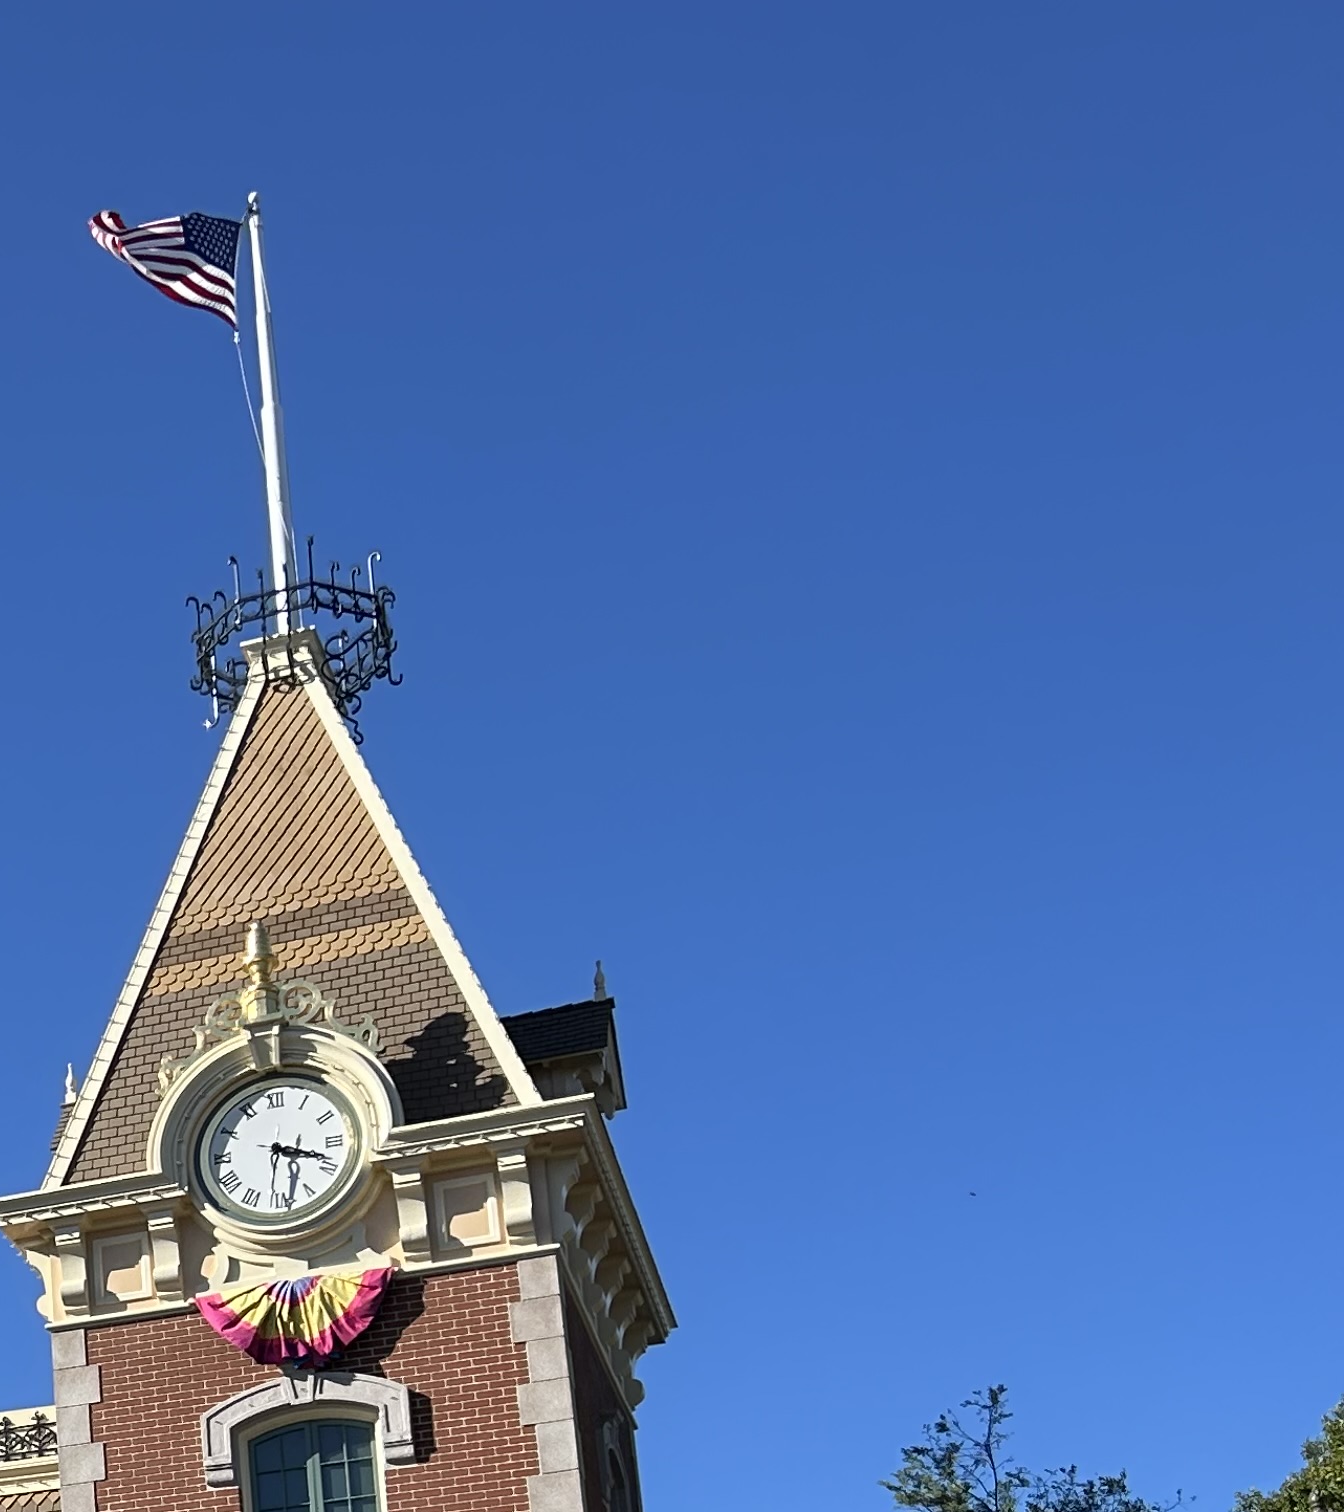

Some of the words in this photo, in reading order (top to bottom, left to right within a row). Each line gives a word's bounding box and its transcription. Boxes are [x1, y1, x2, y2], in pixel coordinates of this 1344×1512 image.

[267, 1092, 284, 1109] XII
[298, 1095, 309, 1110] I
[316, 1110, 334, 1125] II
[326, 1135, 342, 1148] III
